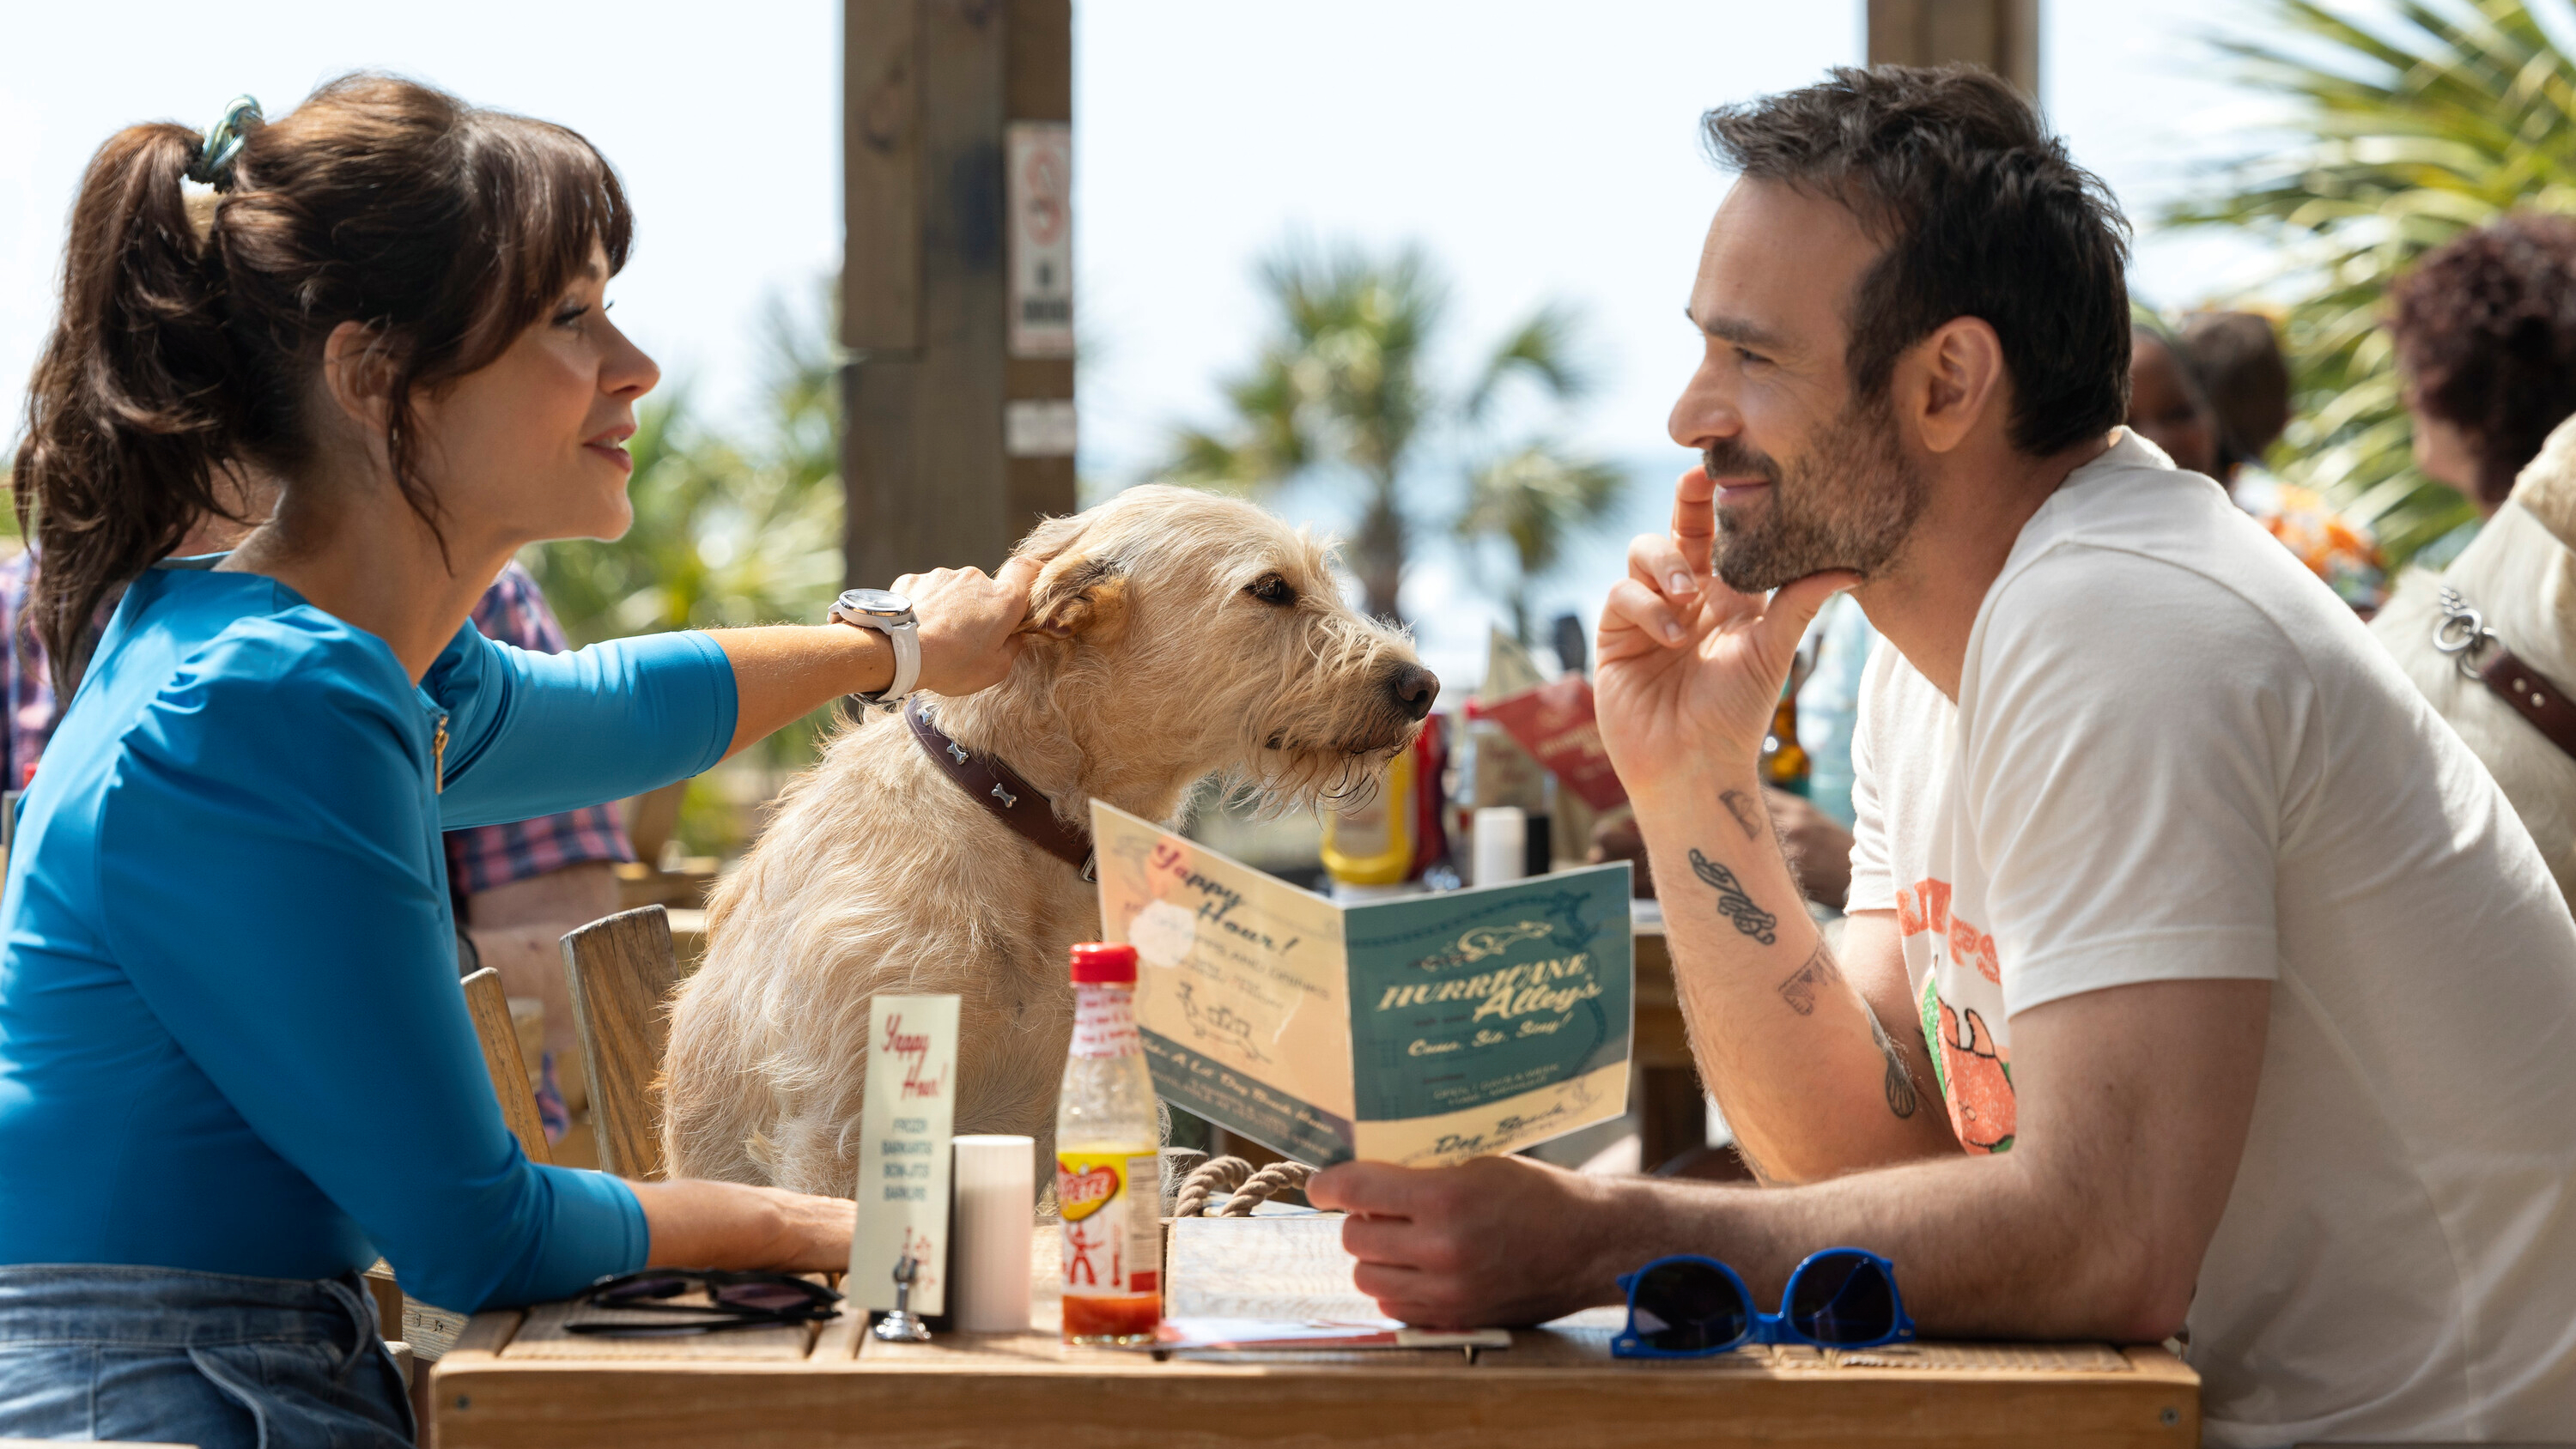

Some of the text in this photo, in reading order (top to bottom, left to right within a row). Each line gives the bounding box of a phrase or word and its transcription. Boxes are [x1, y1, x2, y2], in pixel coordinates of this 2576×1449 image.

[1151, 844, 1244, 906] Yappy
[1197, 900, 1302, 955] Hour!
[1376, 952, 1589, 1012] HURRICANE
[1472, 973, 1604, 1023] Alley's
[881, 1012, 930, 1063] Yappy
